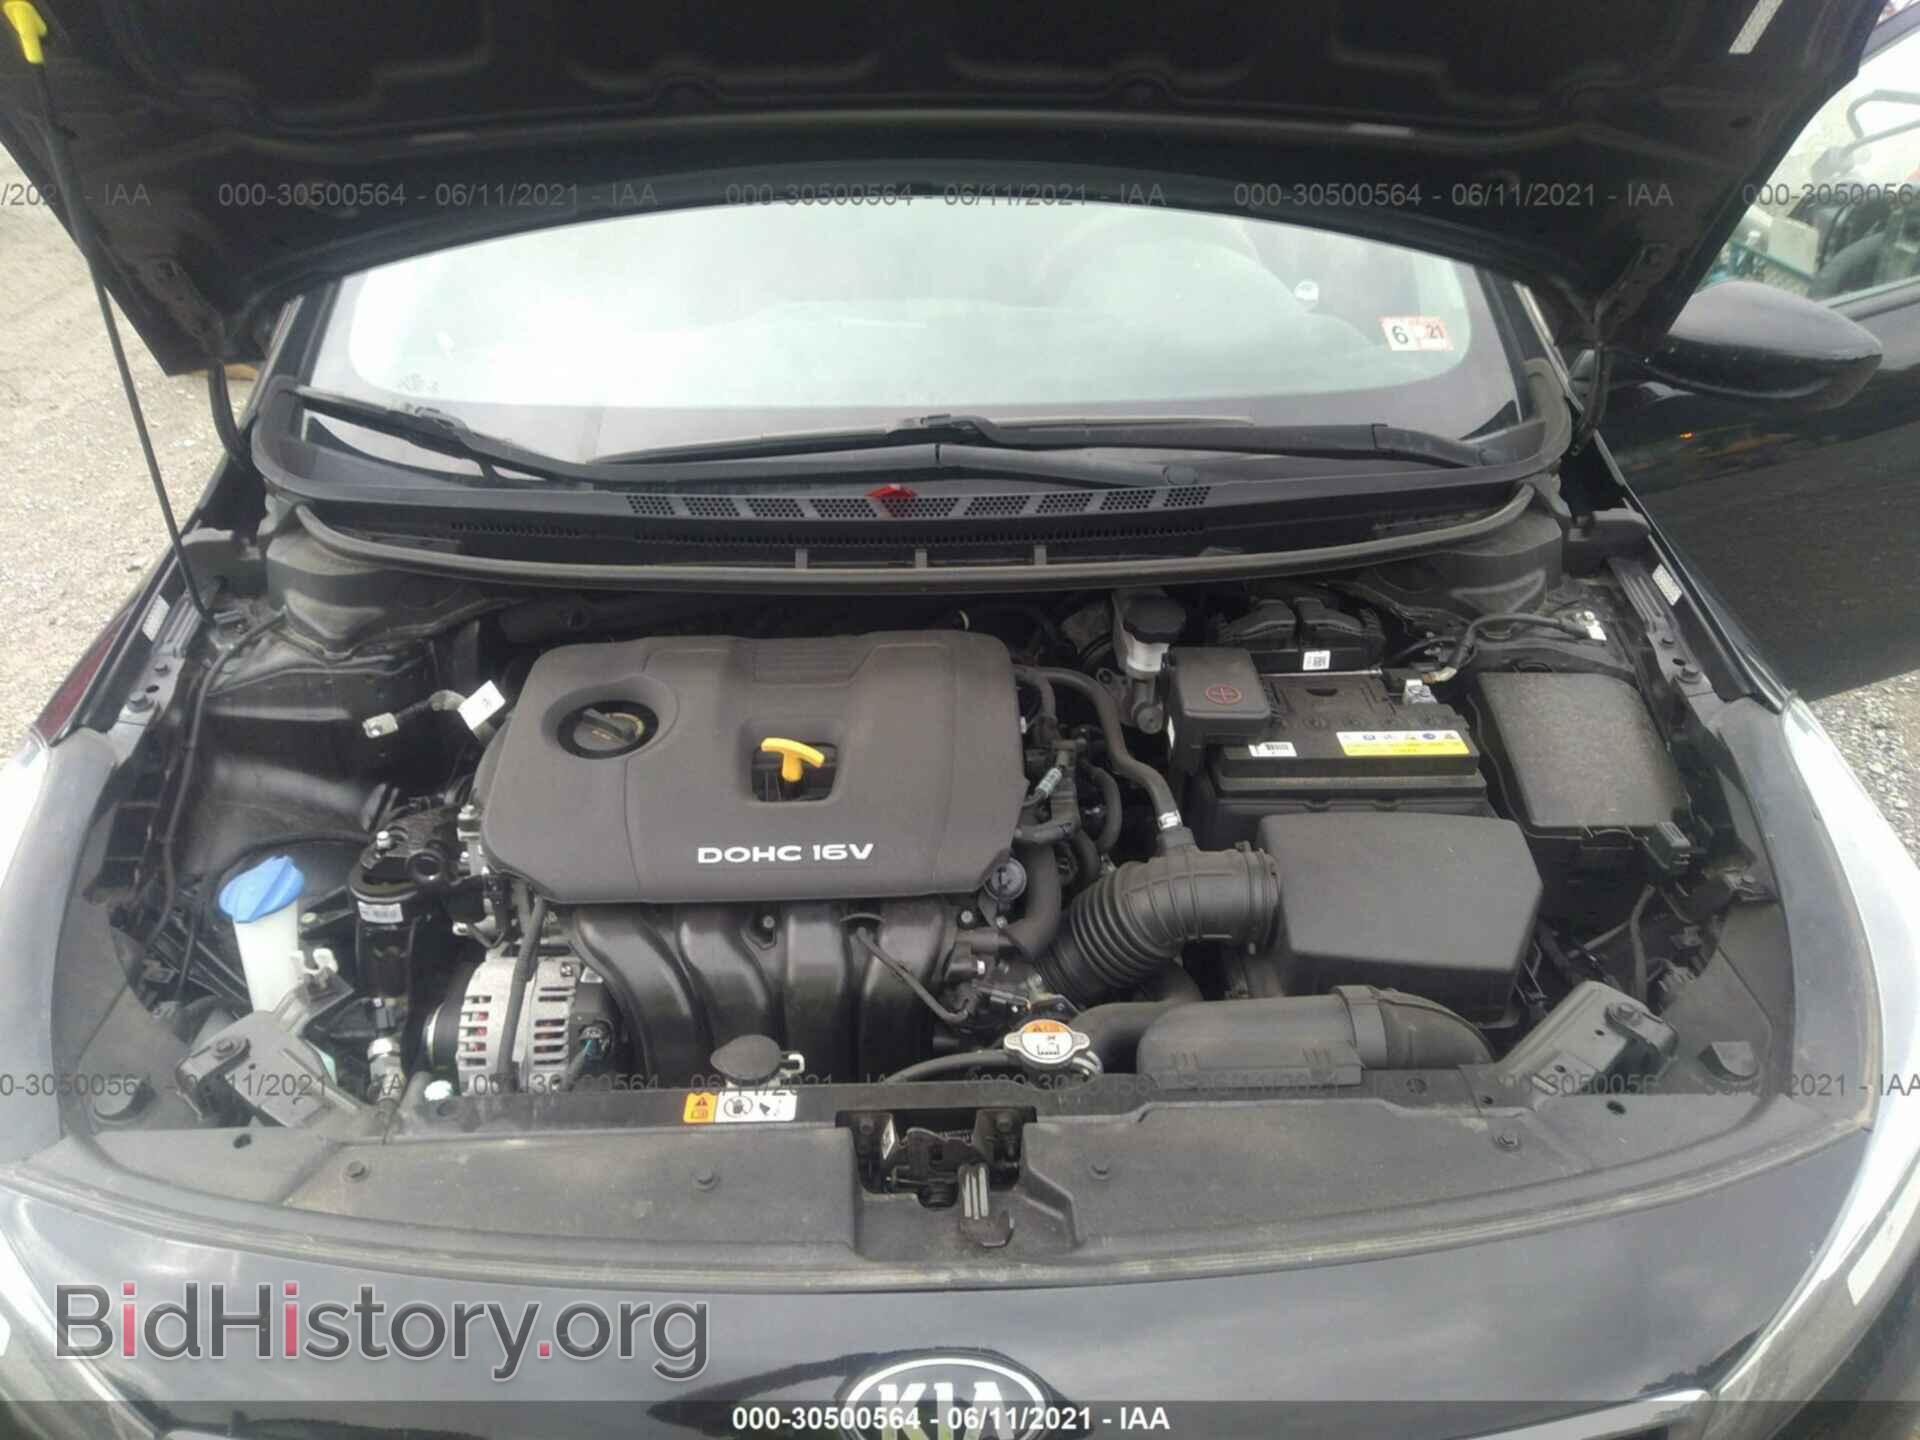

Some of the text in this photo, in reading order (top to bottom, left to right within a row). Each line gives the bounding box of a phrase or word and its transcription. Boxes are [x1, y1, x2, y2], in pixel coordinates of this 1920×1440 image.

[1392, 323, 1445, 344] 6 21
[697, 843, 874, 863] DOHC 16V
[878, 1382, 1015, 1440] KIA
